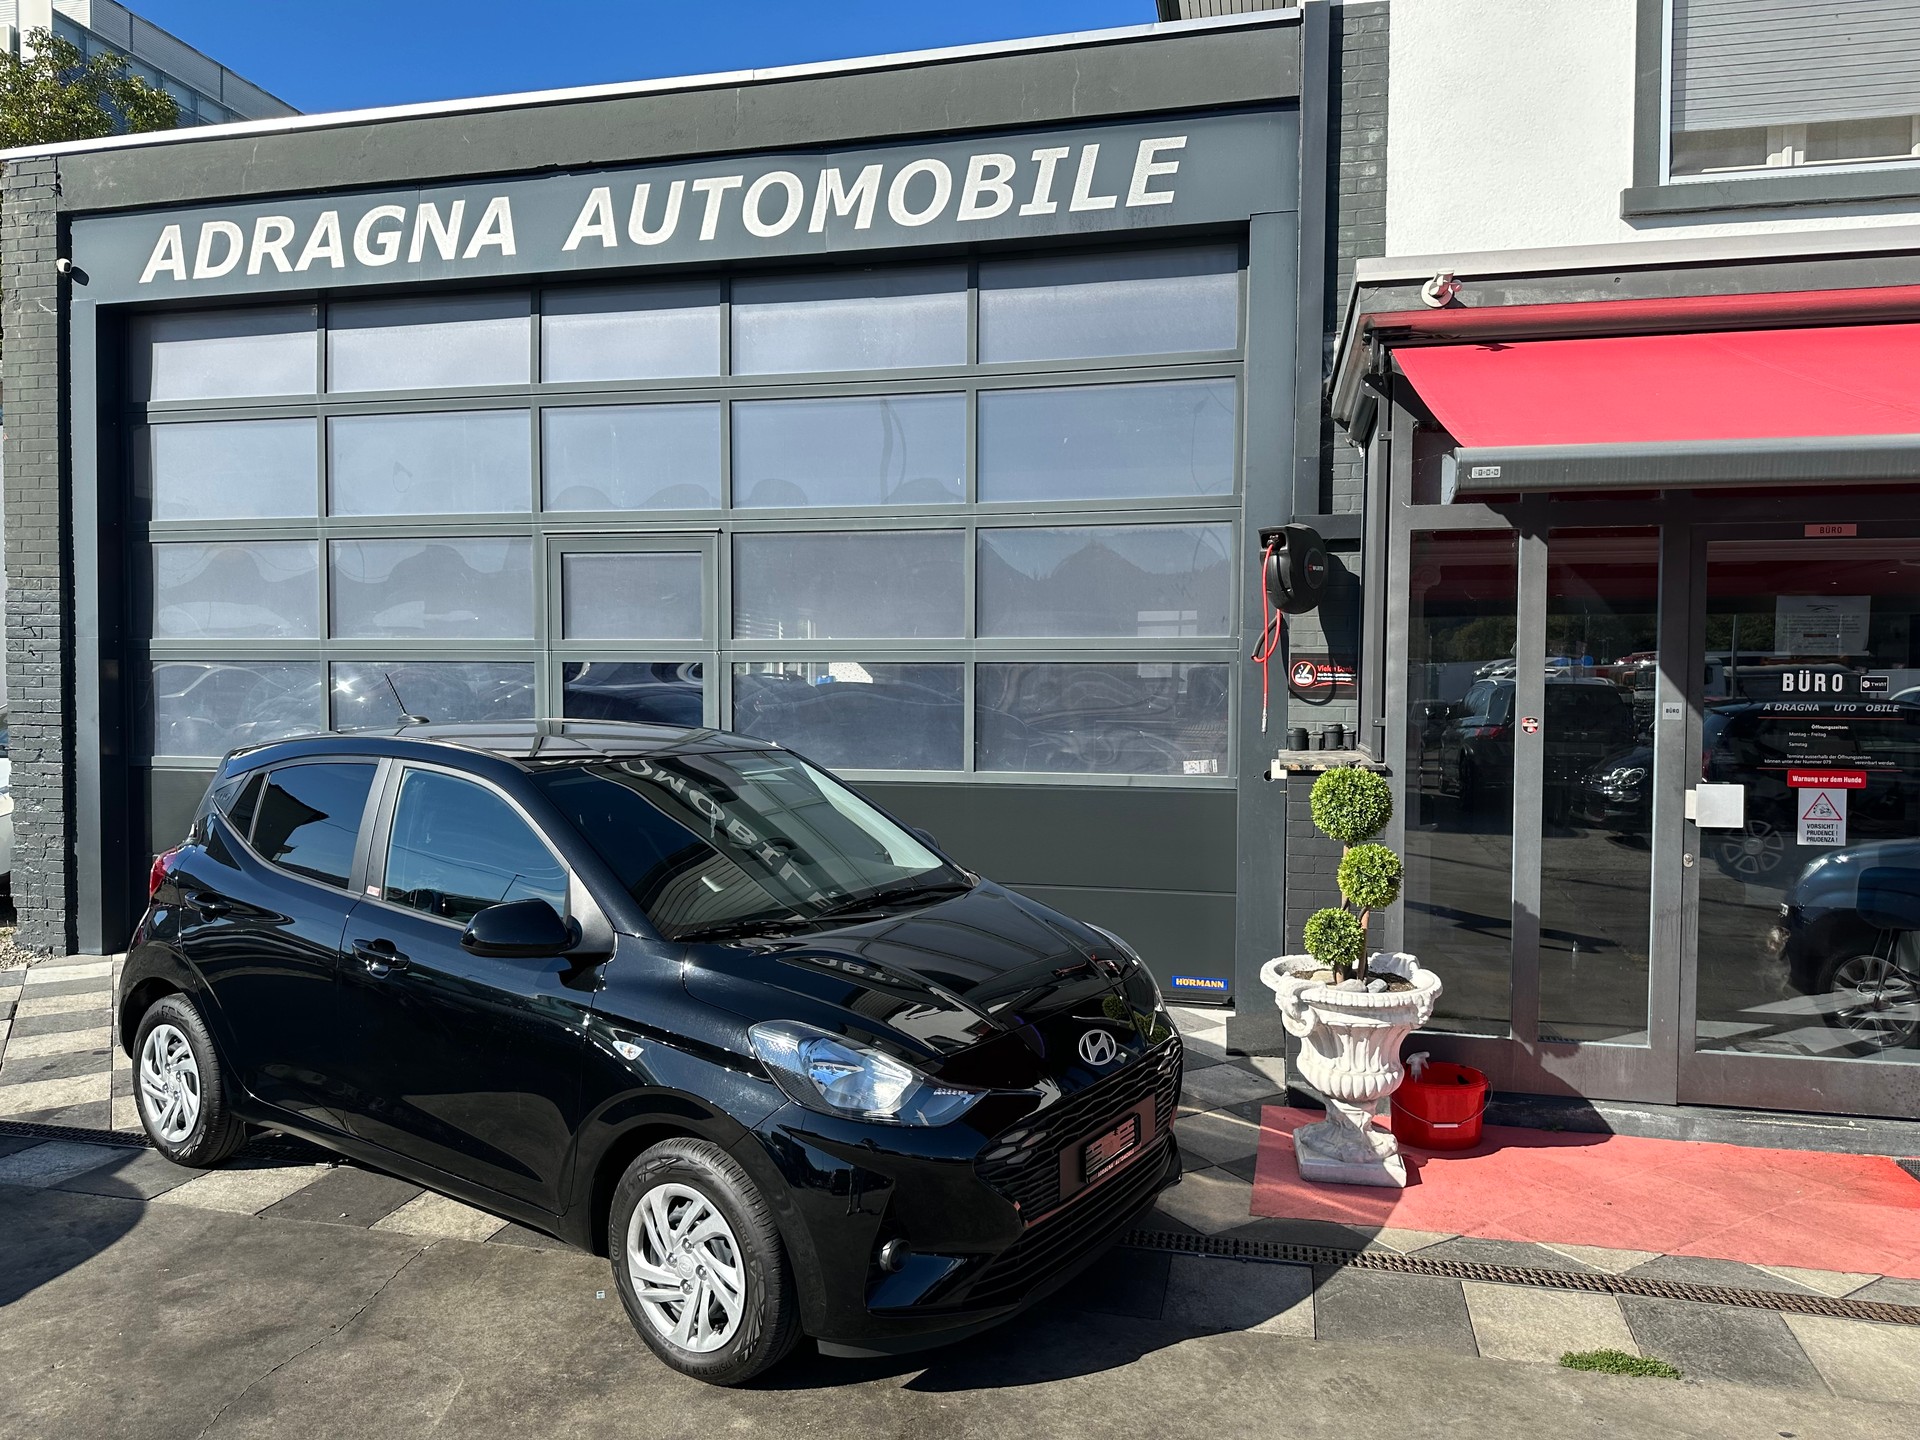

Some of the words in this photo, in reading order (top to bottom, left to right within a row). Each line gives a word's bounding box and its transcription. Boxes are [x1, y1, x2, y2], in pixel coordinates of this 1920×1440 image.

[139, 196, 517, 284] ADRAGNA
[562, 135, 1188, 252] AUTOMOBILE
[1819, 526, 1842, 534] BÜRO
[1782, 670, 1843, 692] BÜRO
[1792, 775, 1819, 784] Warnung
[1175, 977, 1225, 989] HÖRMANN
[709, 1359, 733, 1374] 175/65
